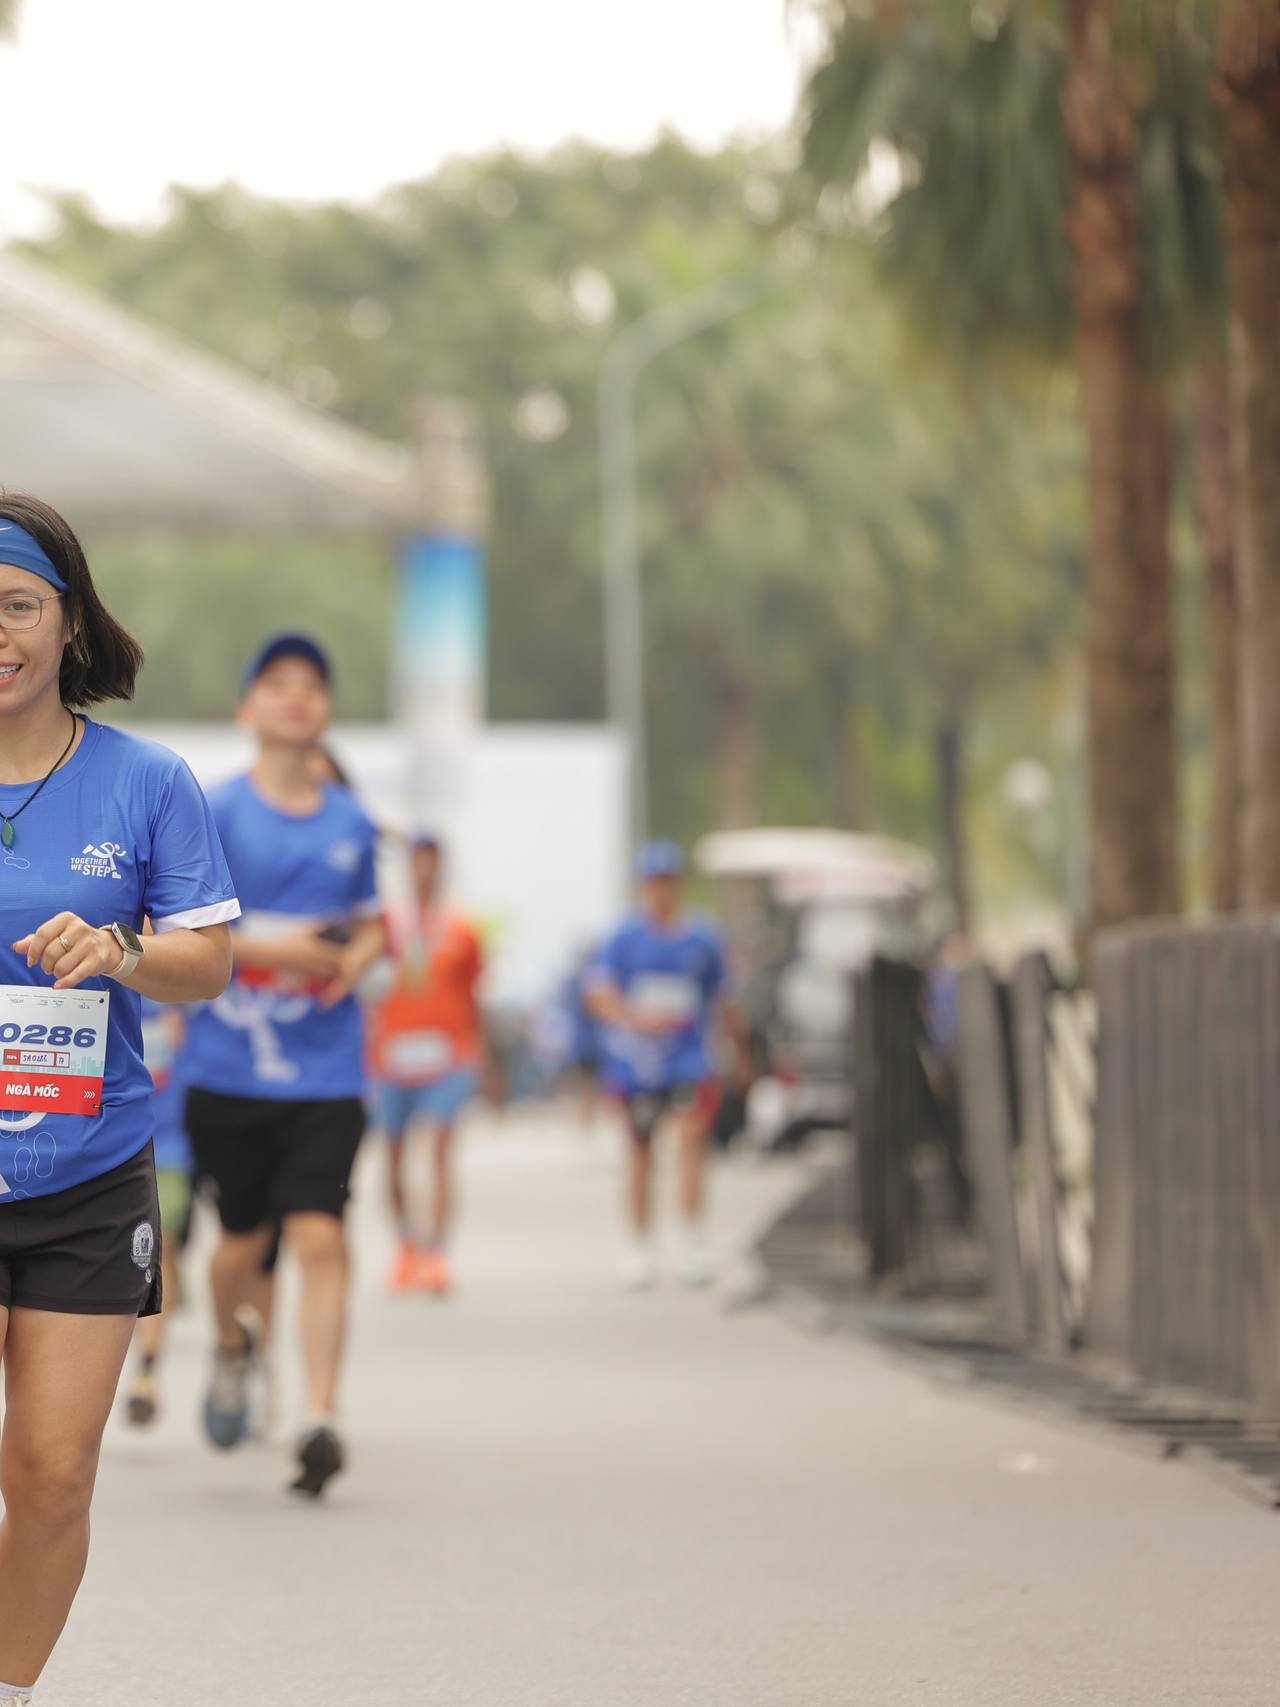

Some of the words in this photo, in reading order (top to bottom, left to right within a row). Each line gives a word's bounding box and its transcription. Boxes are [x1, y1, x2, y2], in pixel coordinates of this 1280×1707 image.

[71, 857, 108, 865] TOGETHER
[82, 864, 110, 877] STEP
[6, 1083, 31, 1096] NGÀ
[34, 1082, 60, 1097] MỐC
